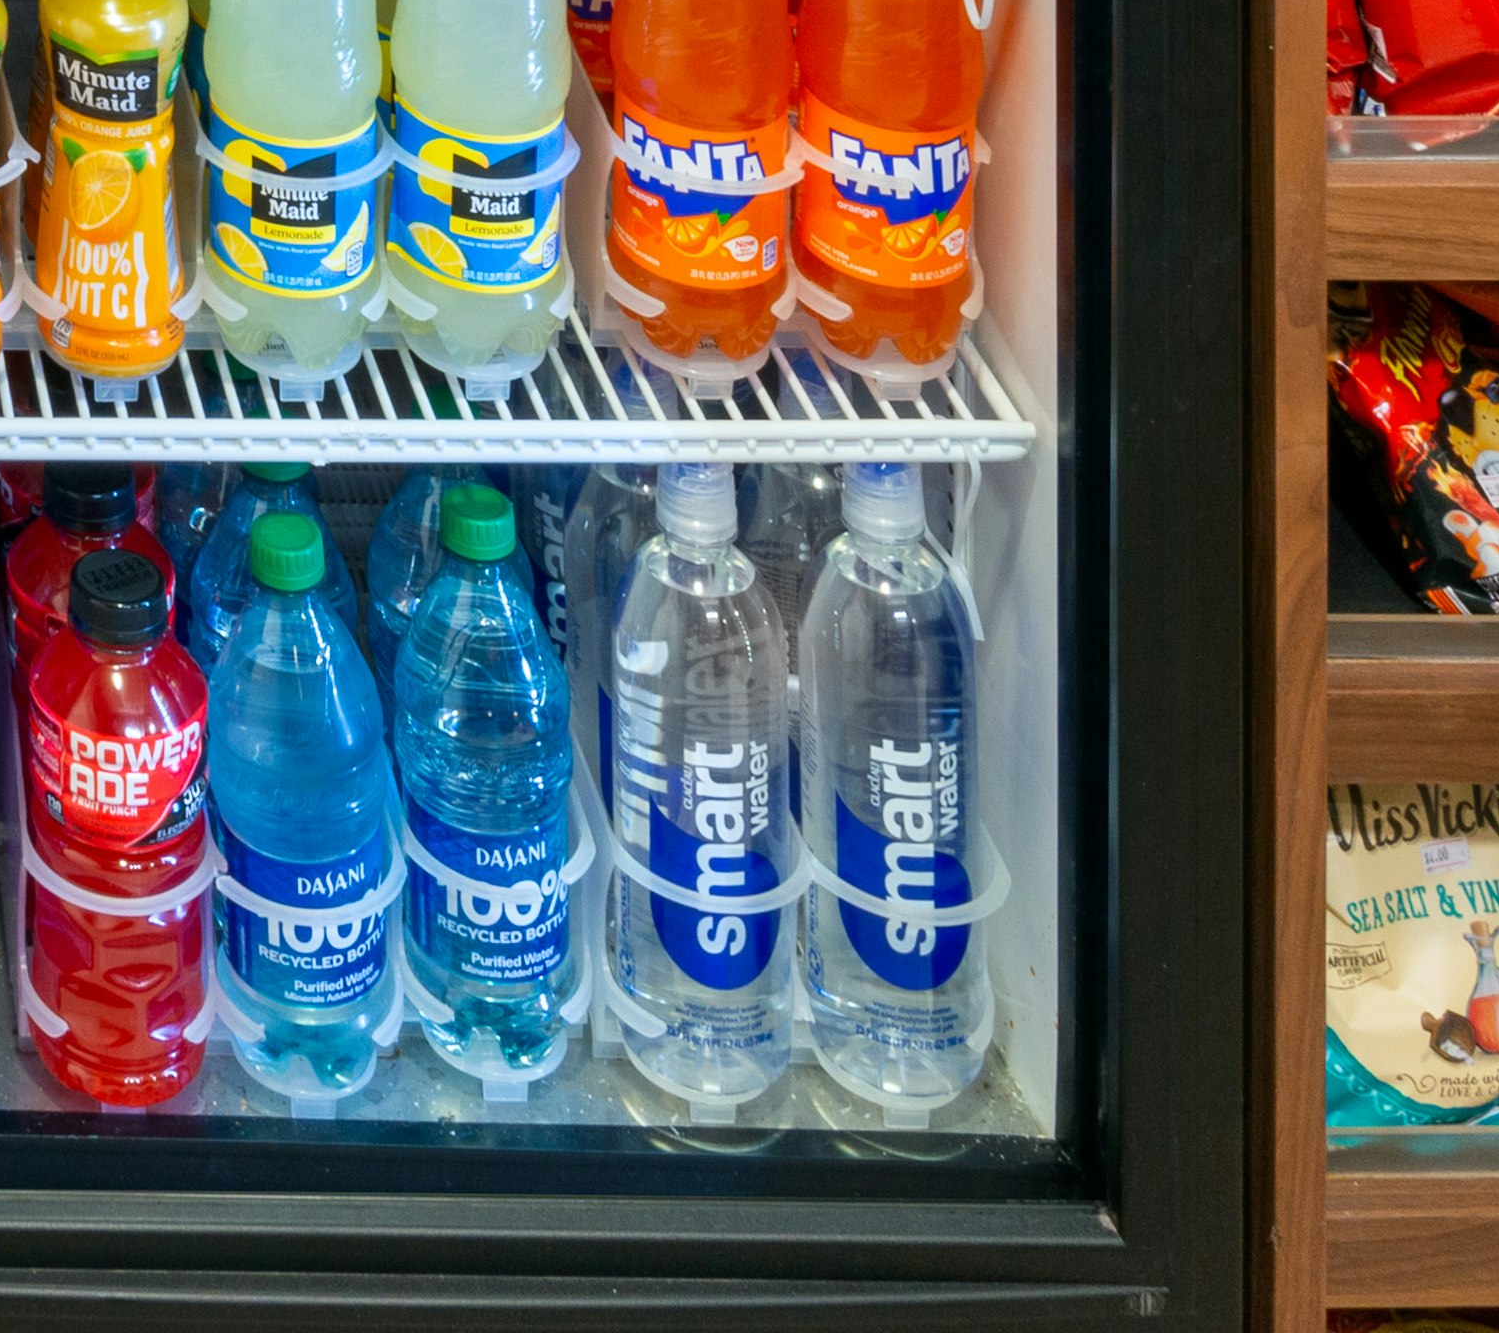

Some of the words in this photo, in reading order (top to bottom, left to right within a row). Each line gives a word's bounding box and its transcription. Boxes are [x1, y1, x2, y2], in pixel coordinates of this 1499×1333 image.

[830, 130, 971, 198] FANTA
[836, 197, 879, 219] orange
[264, 226, 324, 242] Lemonade
[71, 720, 200, 770] POWER
[70, 770, 150, 805] ADE
[749, 741, 768, 835] water
[476, 841, 546, 870] DASANI
[695, 742, 746, 957] smart
[1347, 898, 1384, 931] SEA
[1388, 890, 1429, 925] SALT
[1437, 887, 1455, 917] &
[437, 916, 522, 944] RECYCLED
[470, 951, 518, 969] Purified
[521, 945, 554, 964] Water
